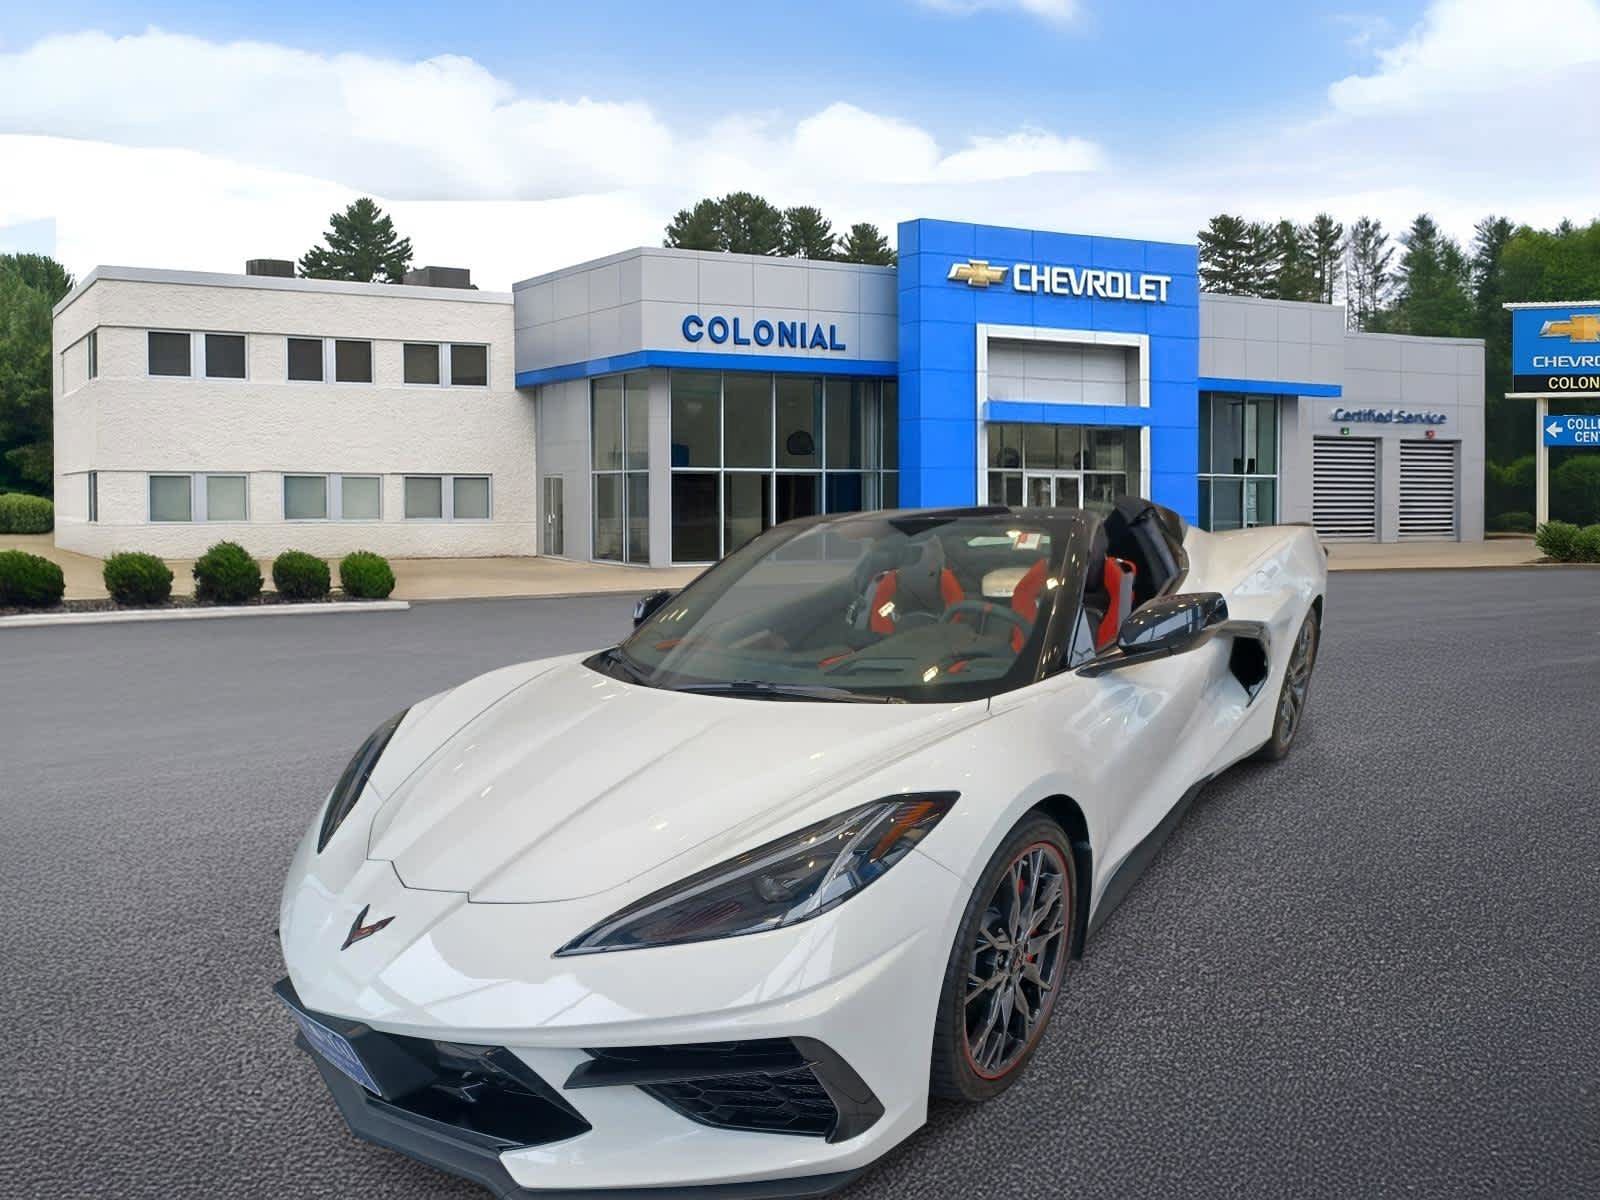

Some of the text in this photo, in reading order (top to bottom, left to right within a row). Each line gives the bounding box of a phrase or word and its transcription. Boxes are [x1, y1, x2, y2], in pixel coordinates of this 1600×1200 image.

[1013, 263, 1172, 302] CHEVROLET
[682, 314, 846, 351] COLONIAL
[1331, 408, 1447, 425] Certified Service
[1575, 431, 1600, 443] CEN
